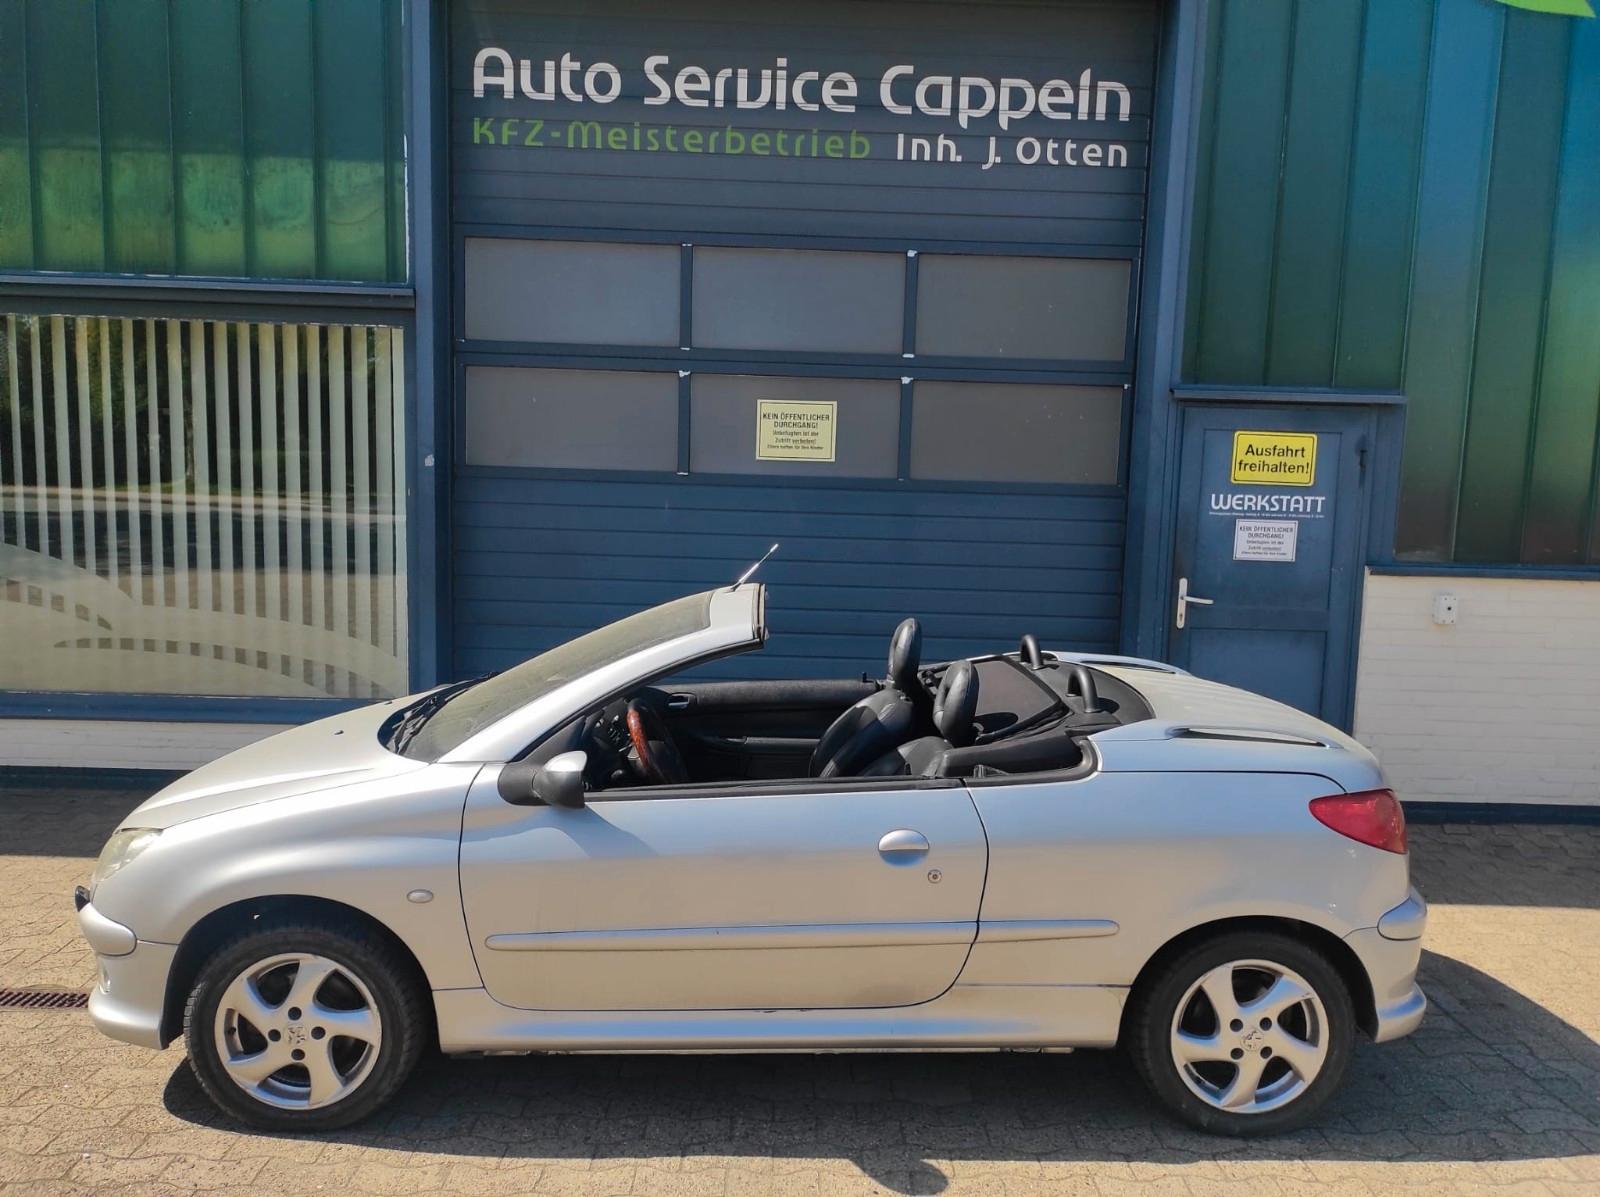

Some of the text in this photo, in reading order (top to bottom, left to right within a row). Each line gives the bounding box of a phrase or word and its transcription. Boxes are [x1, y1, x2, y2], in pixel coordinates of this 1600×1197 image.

[473, 47, 1131, 130] Auto Service Cappeln
[472, 116, 1128, 170] KFZ-Meisterbetrieb Inh. J. Otten
[762, 412, 830, 421] KEIN ÖFFENTLICHER
[773, 421, 818, 429] DURCHGANG!
[1245, 444, 1306, 458] Ausfahrt
[1238, 460, 1310, 474] freihalten!
[1211, 493, 1326, 513] WERKSTATT
